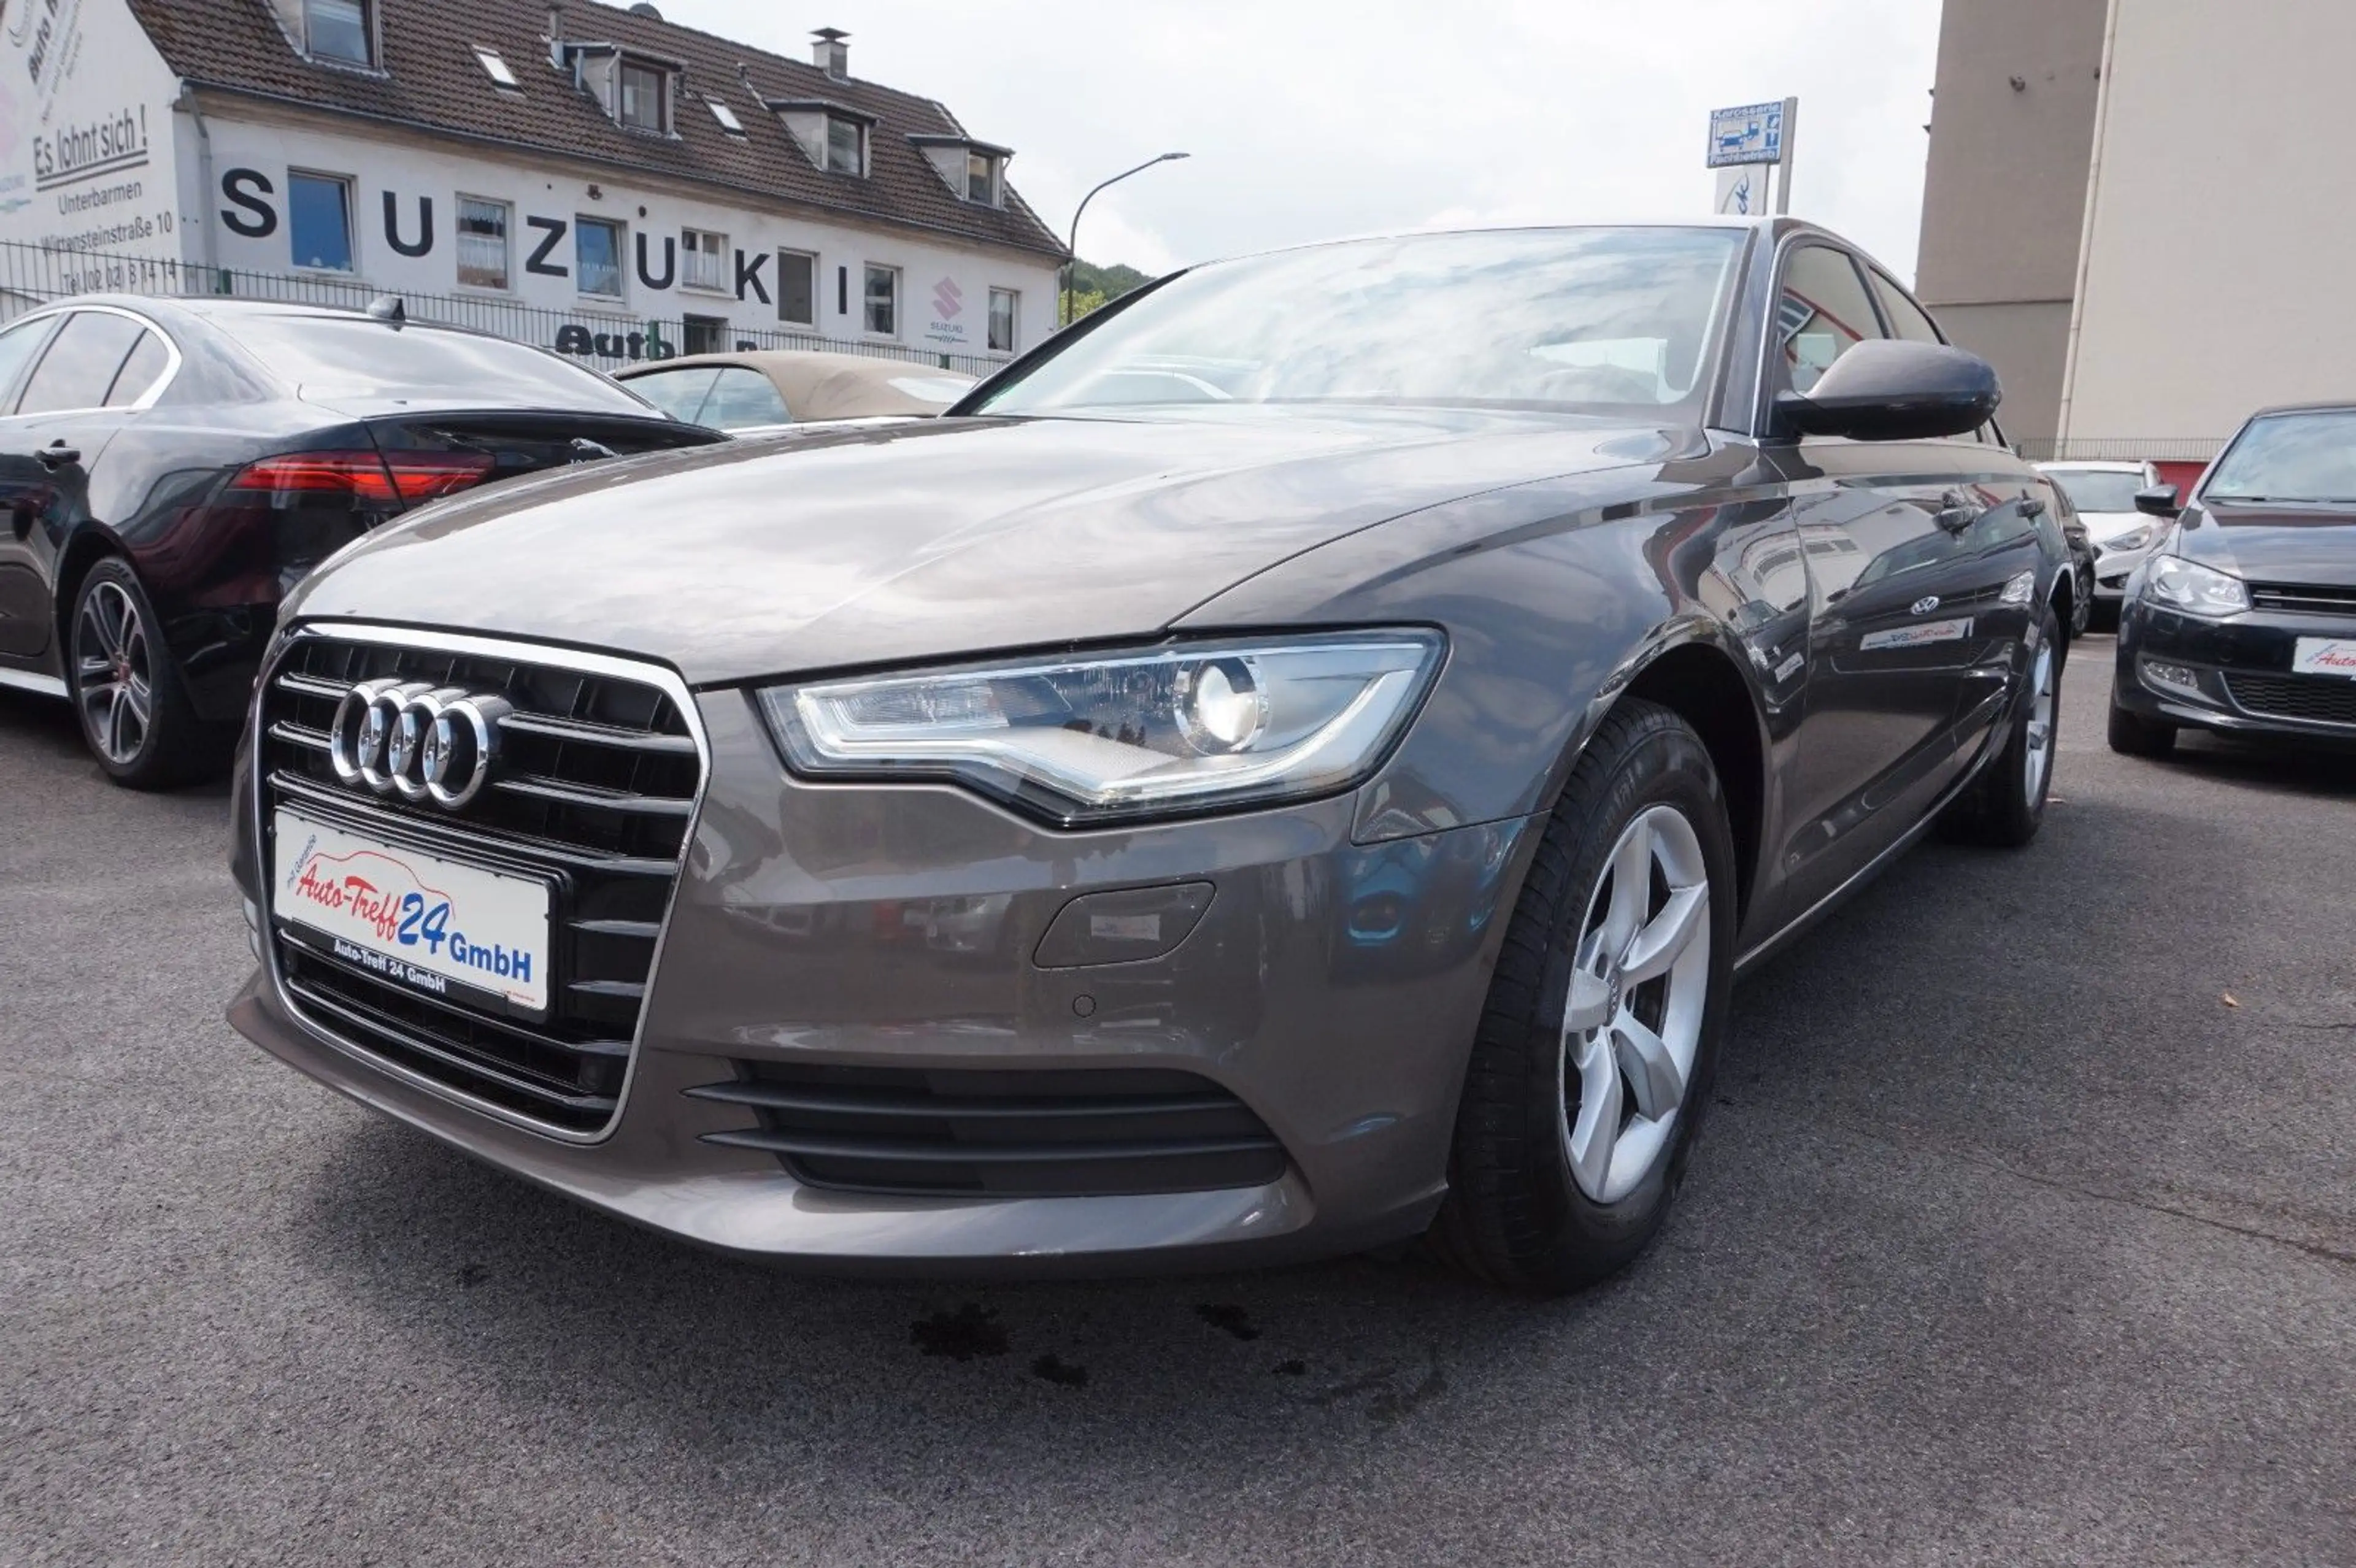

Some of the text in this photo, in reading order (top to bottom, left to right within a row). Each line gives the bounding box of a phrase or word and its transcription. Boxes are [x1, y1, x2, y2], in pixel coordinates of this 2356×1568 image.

[33, 136, 53, 175] Es
[57, 128, 98, 170] lohnt
[58, 182, 142, 215] Unterbarmen
[157, 210, 173, 234] 10
[296, 863, 531, 983] Auto-Treff 24 GmbH
[334, 939, 446, 993] Auto-Treff 24 GmbH
